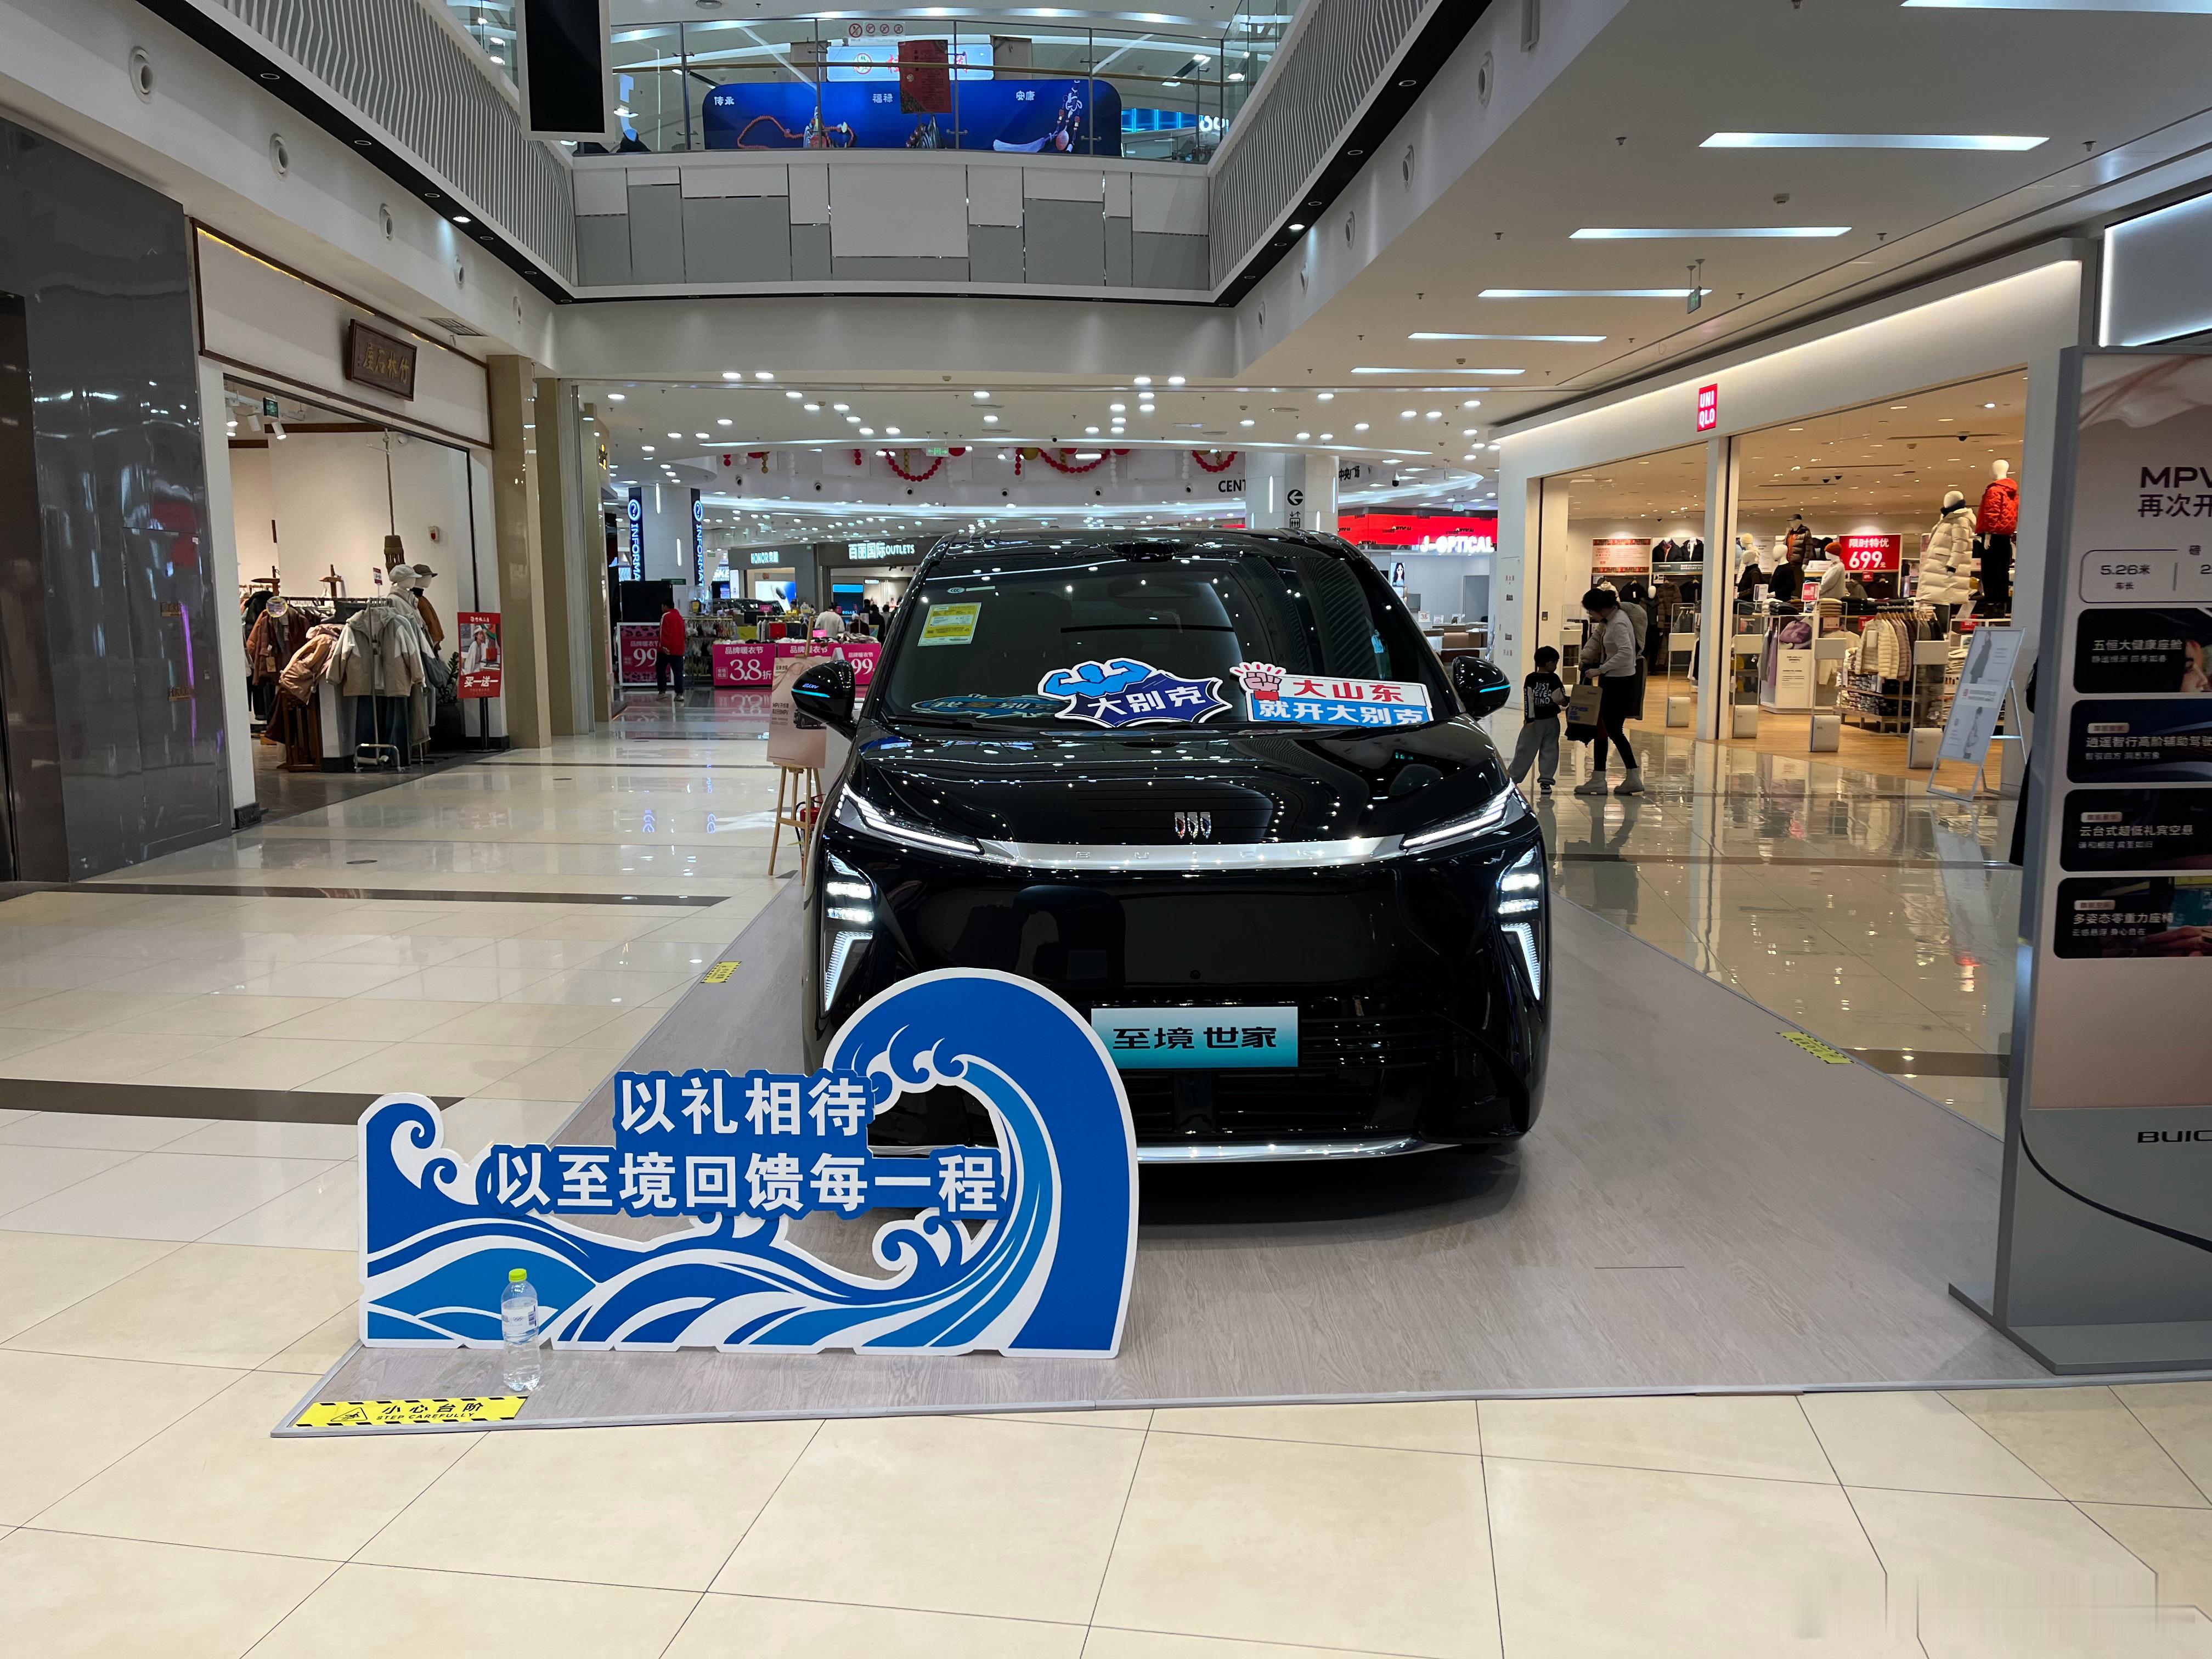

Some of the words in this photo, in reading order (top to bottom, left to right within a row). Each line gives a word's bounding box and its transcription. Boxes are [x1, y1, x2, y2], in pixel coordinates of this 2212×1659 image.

[714, 96, 735, 106] 传承
[1700, 390, 1714, 408] UNI
[1699, 408, 1715, 428] QLO
[1339, 466, 1359, 481] 中央广场
[1218, 480, 1246, 492] CENT
[2138, 494, 2212, 517] 再次开
[885, 544, 915, 555] OUTLETS
[1420, 535, 1494, 552] J-OPTICAL
[1848, 538, 1889, 548] 限时特优
[751, 552, 768, 564] HONOR
[2101, 565, 2151, 575] 5.26米
[725, 646, 763, 654] 品牌暖衣节
[1292, 679, 1404, 704] 大山东
[1087, 685, 1207, 720] 大别克
[1259, 699, 1424, 726] 就开大别克
[1113, 1027, 1195, 1049] 至境
[1203, 1026, 1277, 1048] 世家
[620, 1078, 867, 1136] 以礼相待
[2137, 1130, 2212, 1143] BUIC
[496, 1152, 998, 1213] 以至境回馈每一程
[382, 1402, 484, 1414] 小心台阶
